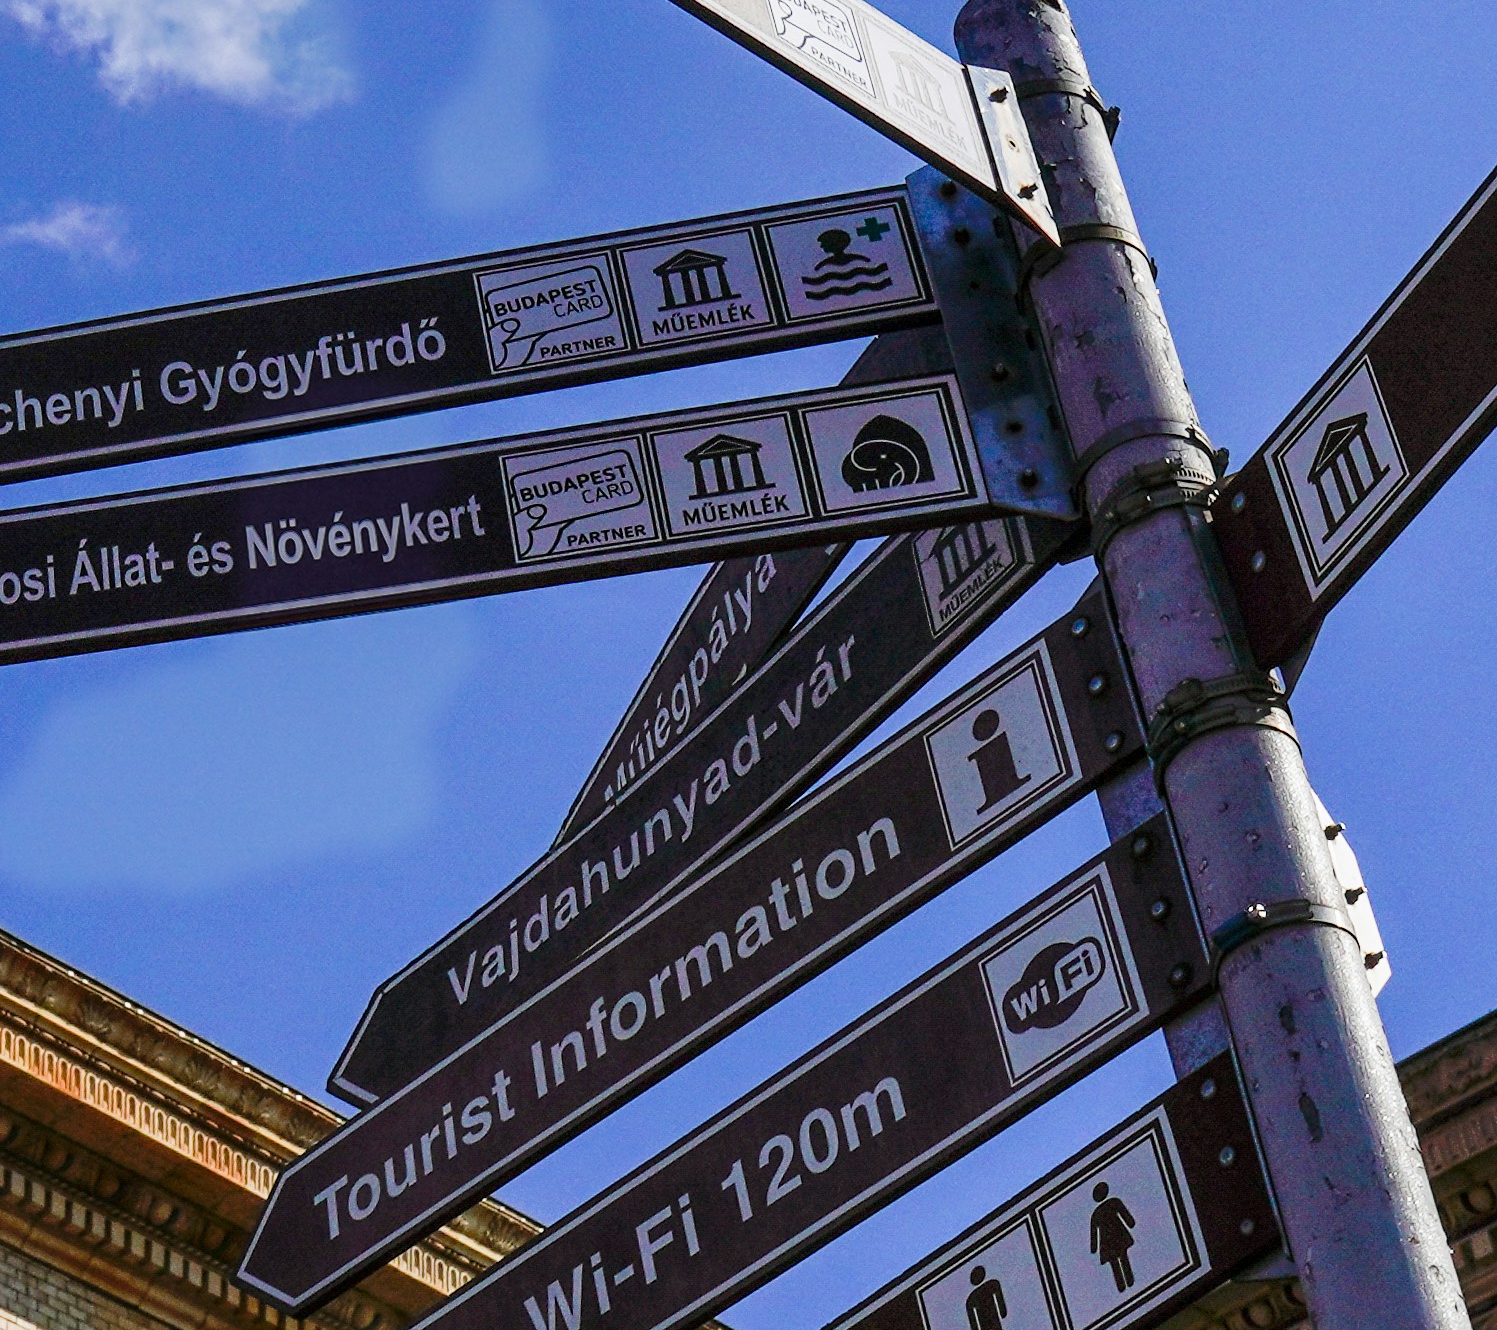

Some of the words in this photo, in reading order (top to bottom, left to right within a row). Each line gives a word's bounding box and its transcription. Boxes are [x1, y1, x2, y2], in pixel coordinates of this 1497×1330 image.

[817, 19, 855, 49] CARD
[811, 46, 868, 89] PARTNER
[494, 279, 598, 317] BUDAPEST
[554, 294, 604, 319] CARD
[652, 303, 755, 336] MŰEMLÉK
[159, 316, 447, 412] Gyógyfürdő
[540, 336, 617, 359] PARTNER
[520, 463, 628, 502] BUDAPEST
[581, 480, 634, 504] CARD
[682, 493, 790, 527] MŰEMLÉK
[69, 537, 174, 595] Állat-
[187, 535, 234, 578] és
[245, 494, 485, 569] Növénykert
[567, 525, 647, 547] PARTNER
[448, 635, 855, 1006] Vajdahunyad-vár
[313, 1070, 516, 1241] Tourist
[531, 816, 901, 1099] Information
[721, 1076, 906, 1222] 120m
